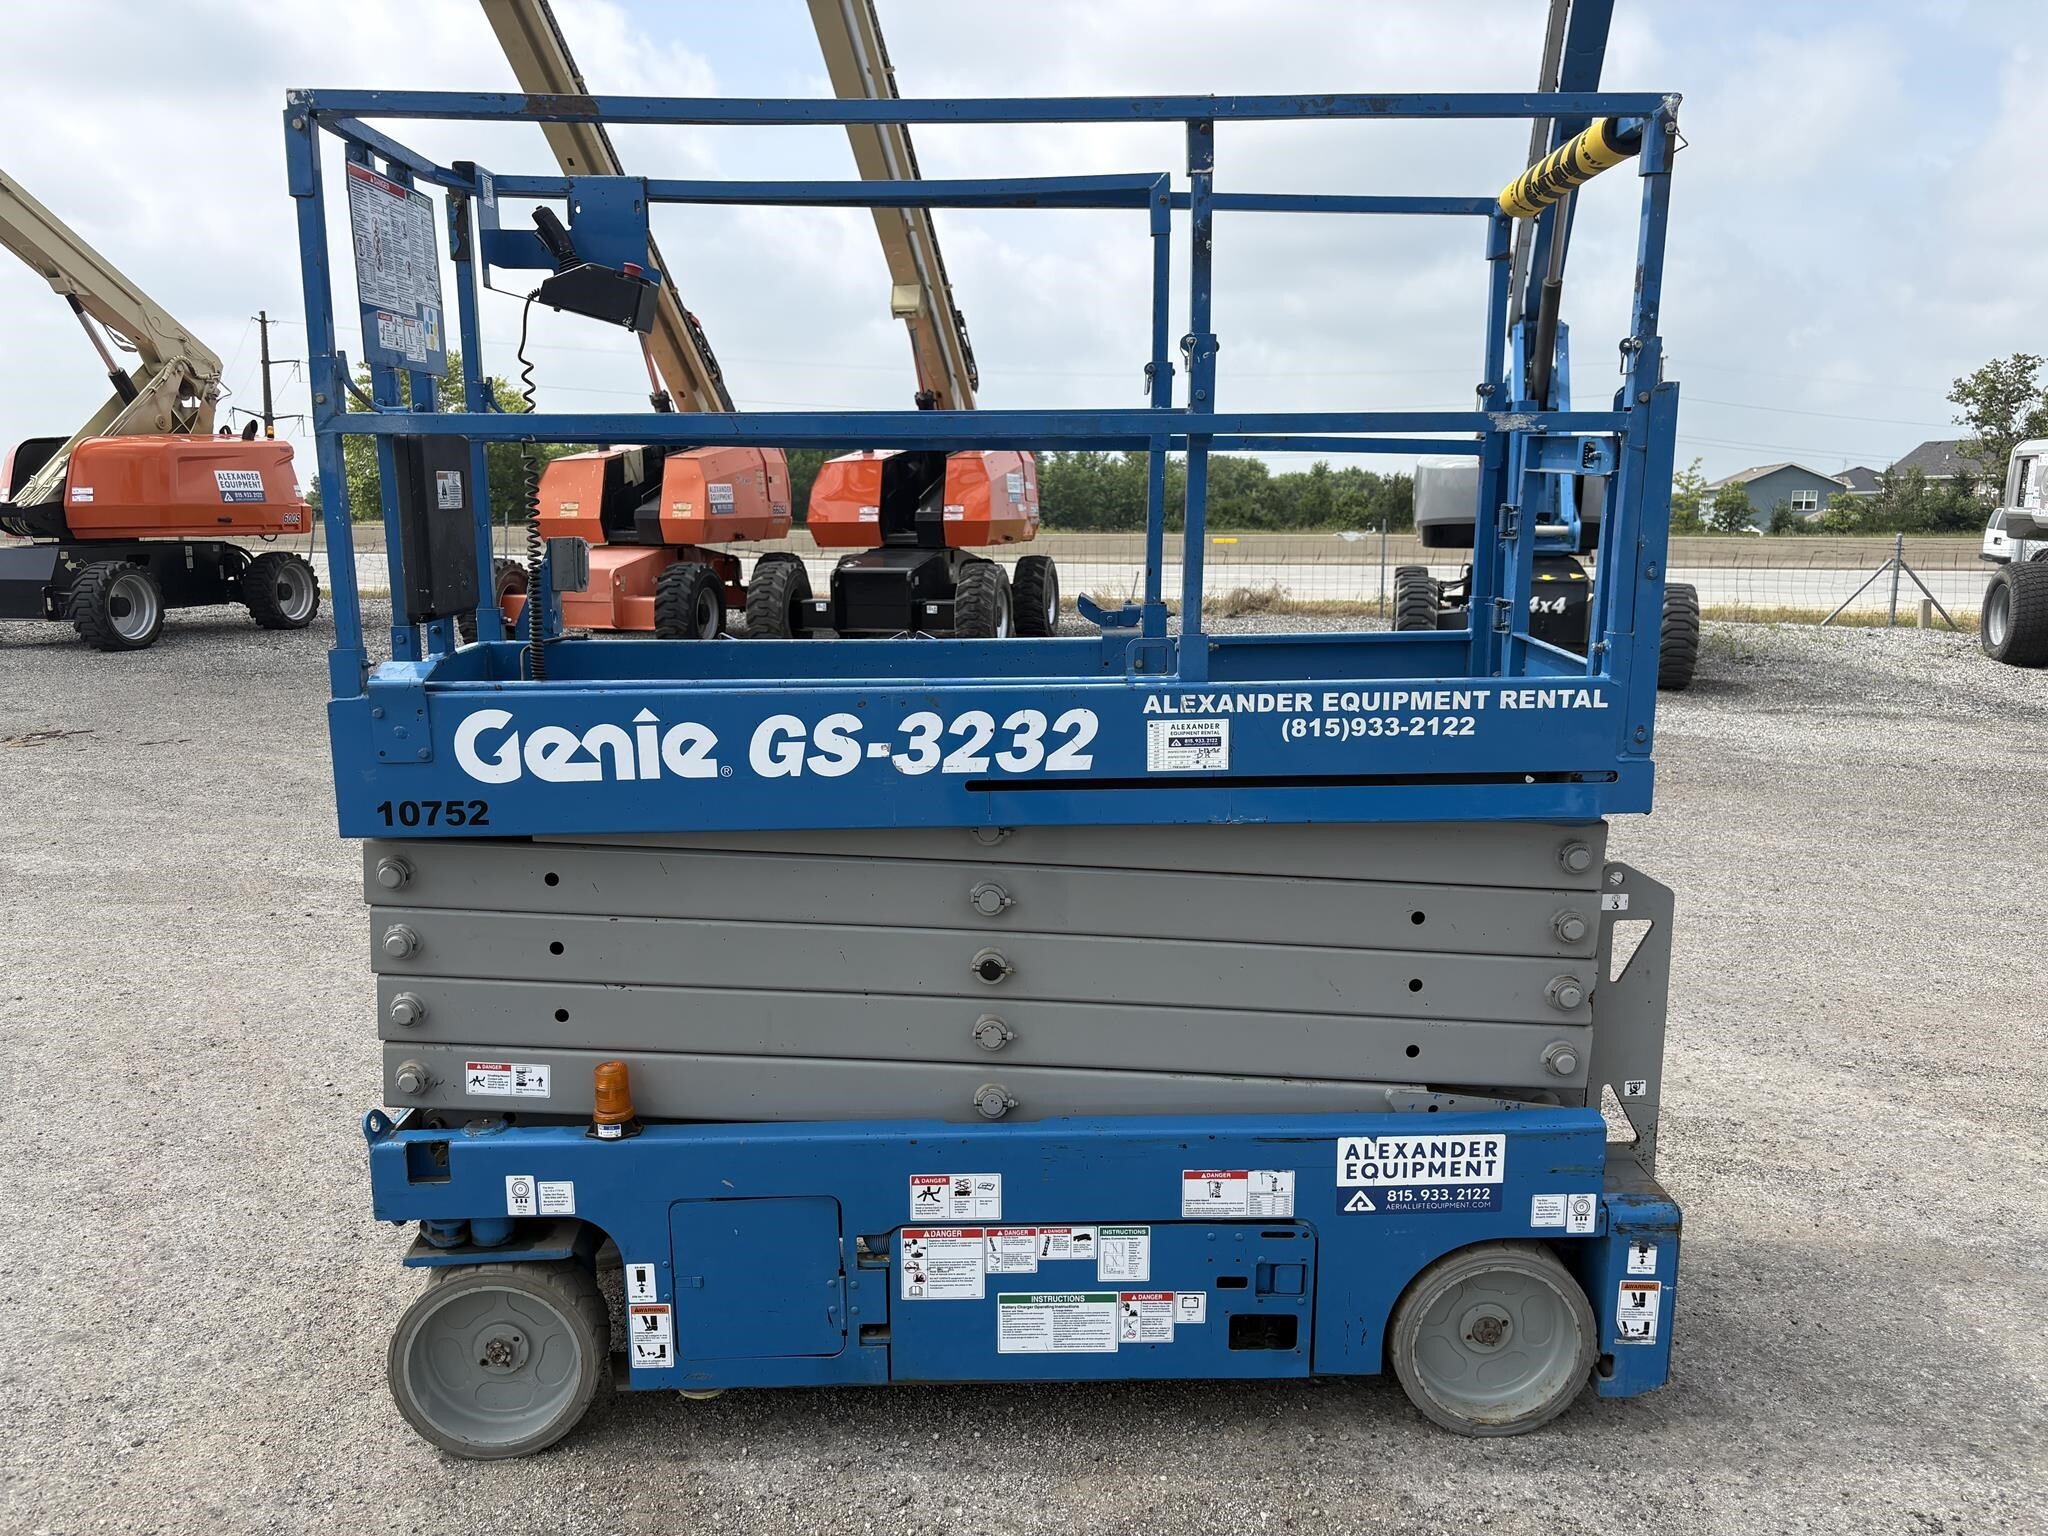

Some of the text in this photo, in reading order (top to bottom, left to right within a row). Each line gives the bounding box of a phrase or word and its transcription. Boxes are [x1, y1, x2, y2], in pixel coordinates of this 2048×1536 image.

[217, 472, 260, 481] ALEXANDER
[219, 480, 262, 489] EQUIPMENT
[283, 513, 300, 524] 600S
[1529, 596, 1567, 614] 4x4
[1142, 688, 1609, 715] ALEXANDER EQUIPMENT RENTAL
[1281, 716, 1476, 743] (815)933-2122
[453, 707, 719, 784] Genie
[749, 708, 1100, 778] GS-3232
[377, 801, 490, 827] 10752
[1344, 1141, 1498, 1160] ALEXANDER
[1346, 1160, 1497, 1180] EQUIPMENT
[1031, 1295, 1085, 1303] INSTRUCTIONS
